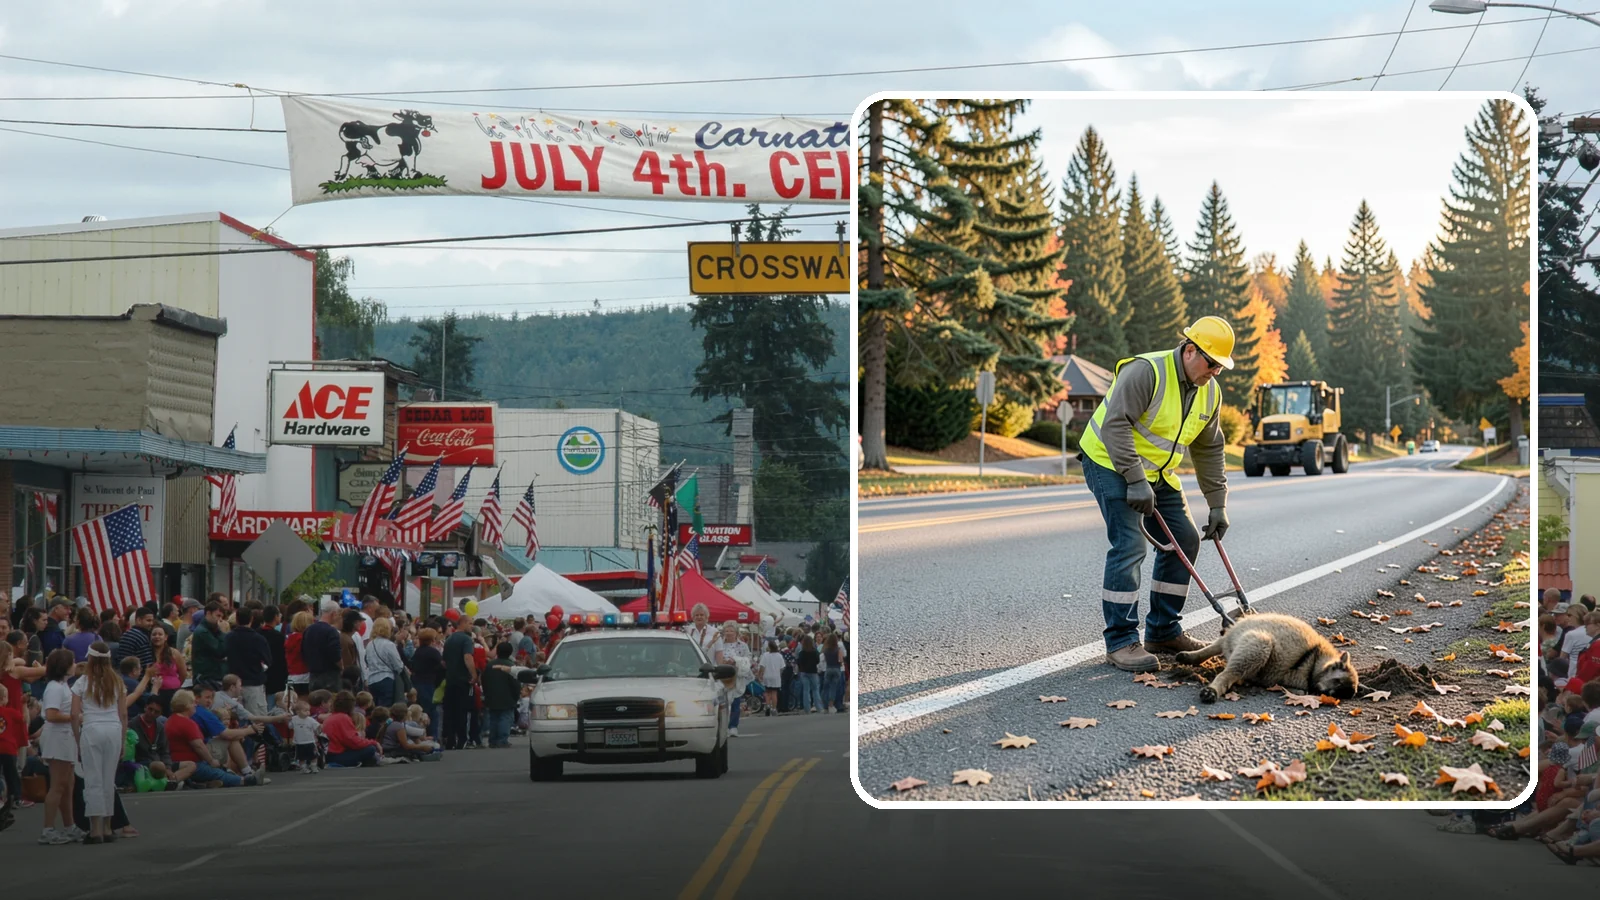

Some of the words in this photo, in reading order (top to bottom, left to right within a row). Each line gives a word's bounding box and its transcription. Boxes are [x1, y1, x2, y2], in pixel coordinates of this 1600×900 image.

[481, 141, 603, 193] JULY
[630, 150, 747, 198] 4th.
[283, 380, 373, 420] ACE
[405, 409, 452, 422] CEDAR
[461, 410, 485, 422] LOG
[283, 421, 370, 436] Hardware
[416, 428, 476, 447] Coca-Cola
[83, 484, 93, 494] St.
[96, 485, 124, 494] Vincent
[126, 485, 136, 495] de
[137, 486, 155, 496] Paul
[688, 526, 741, 535] CRNATION
[699, 535, 730, 543] GLASS
